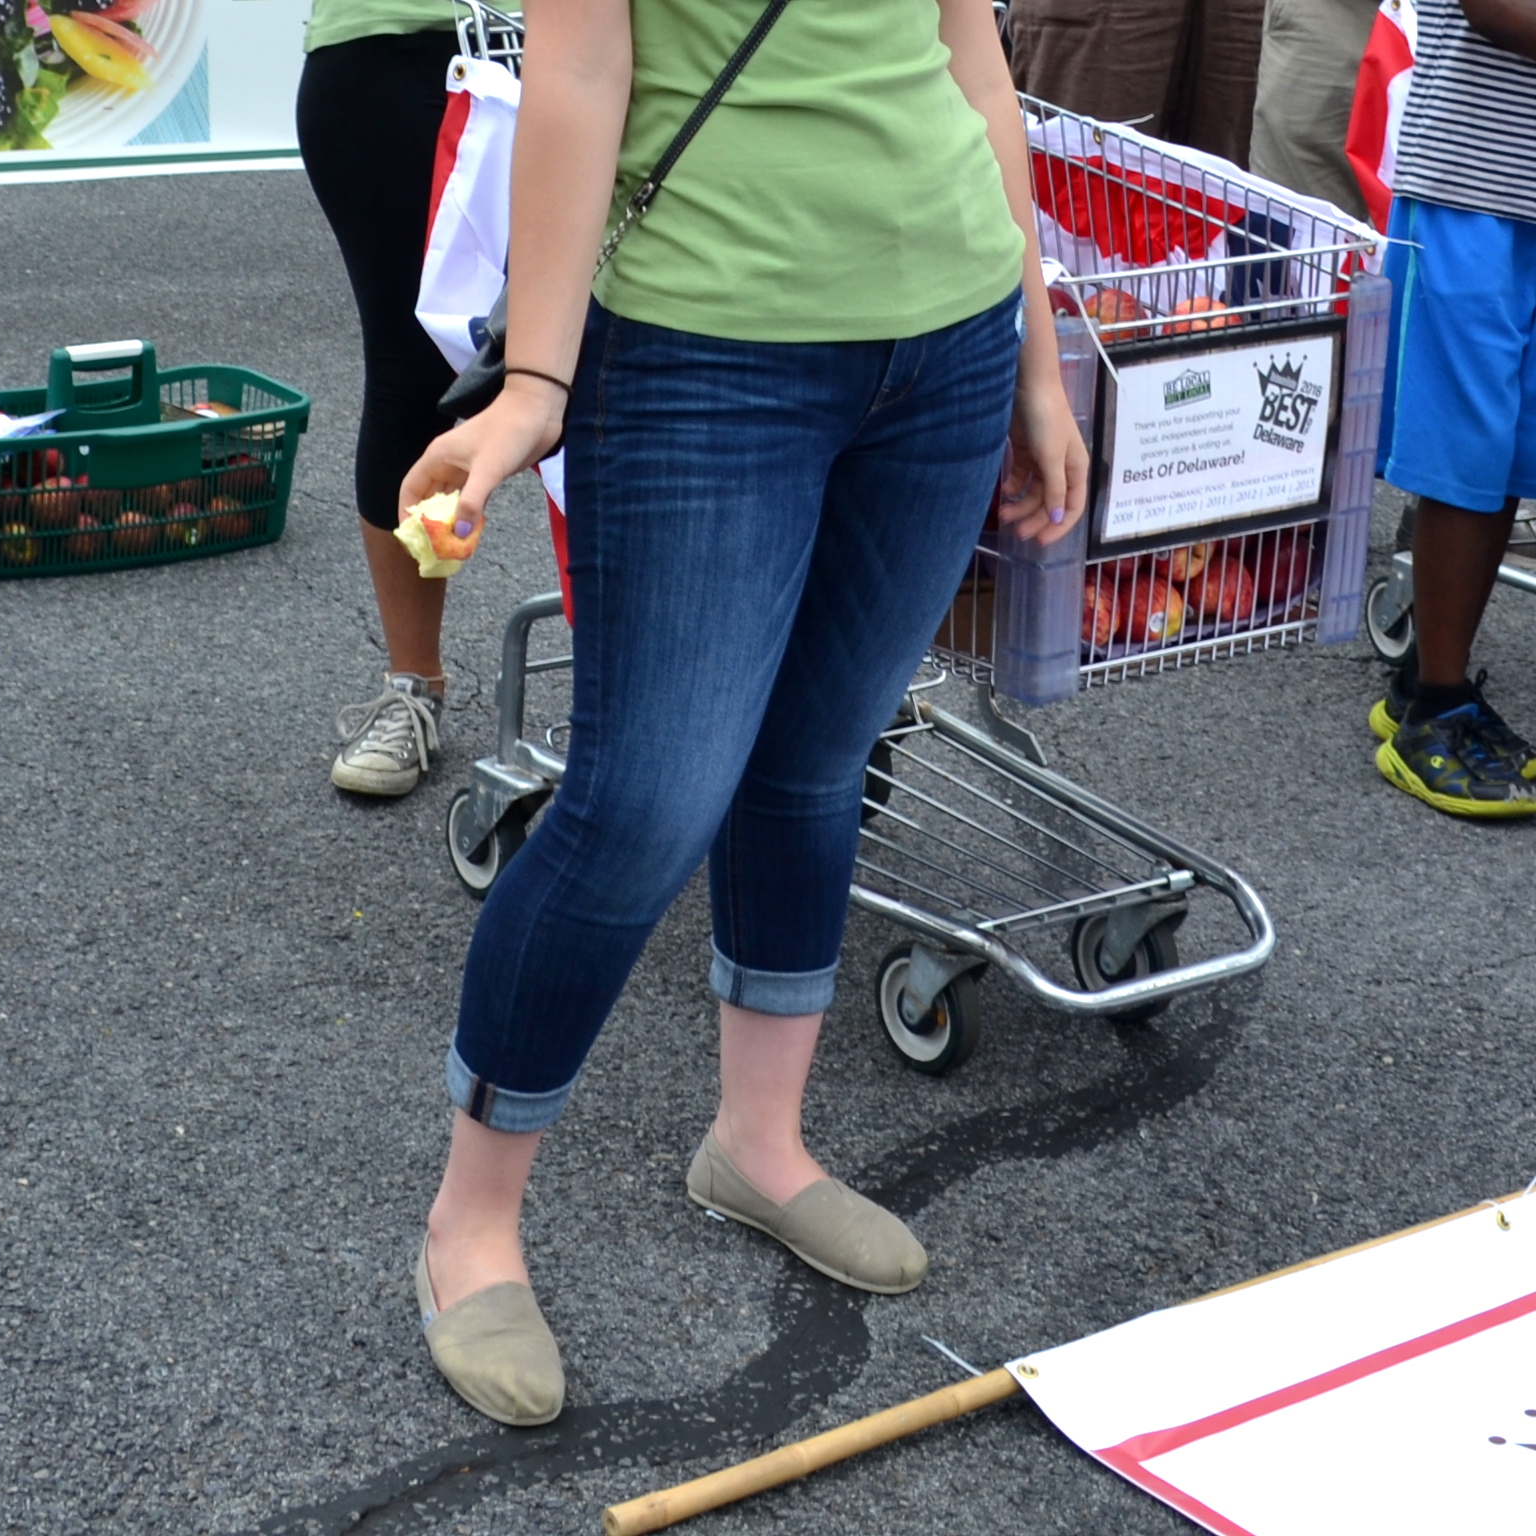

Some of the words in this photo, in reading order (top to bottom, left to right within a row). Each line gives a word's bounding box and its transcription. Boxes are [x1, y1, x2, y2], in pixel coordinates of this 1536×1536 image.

[1180, 370, 1210, 390] LOCAL
[1301, 380, 1323, 398] 2016
[1134, 421, 1156, 431] Thank
[1158, 419, 1172, 429] you
[1173, 415, 1183, 425] for
[1185, 409, 1224, 423] supporting
[1225, 407, 1241, 418] your
[1259, 383, 1318, 435] BEST
[1161, 426, 1207, 442] independent
[1208, 422, 1233, 433] natural
[1253, 423, 1305, 454] Delaware
[1141, 447, 1169, 461] grocery
[1172, 444, 1191, 455] store
[1123, 466, 1154, 484] Best
[1157, 461, 1174, 478] Of
[1176, 450, 1245, 475] Delaware!
[1112, 510, 1134, 525] 2008
[1144, 505, 1166, 520] 2009
[1175, 500, 1197, 514] 2010
[1206, 495, 1226, 509] 2011
[1236, 489, 1257, 502] 2012
